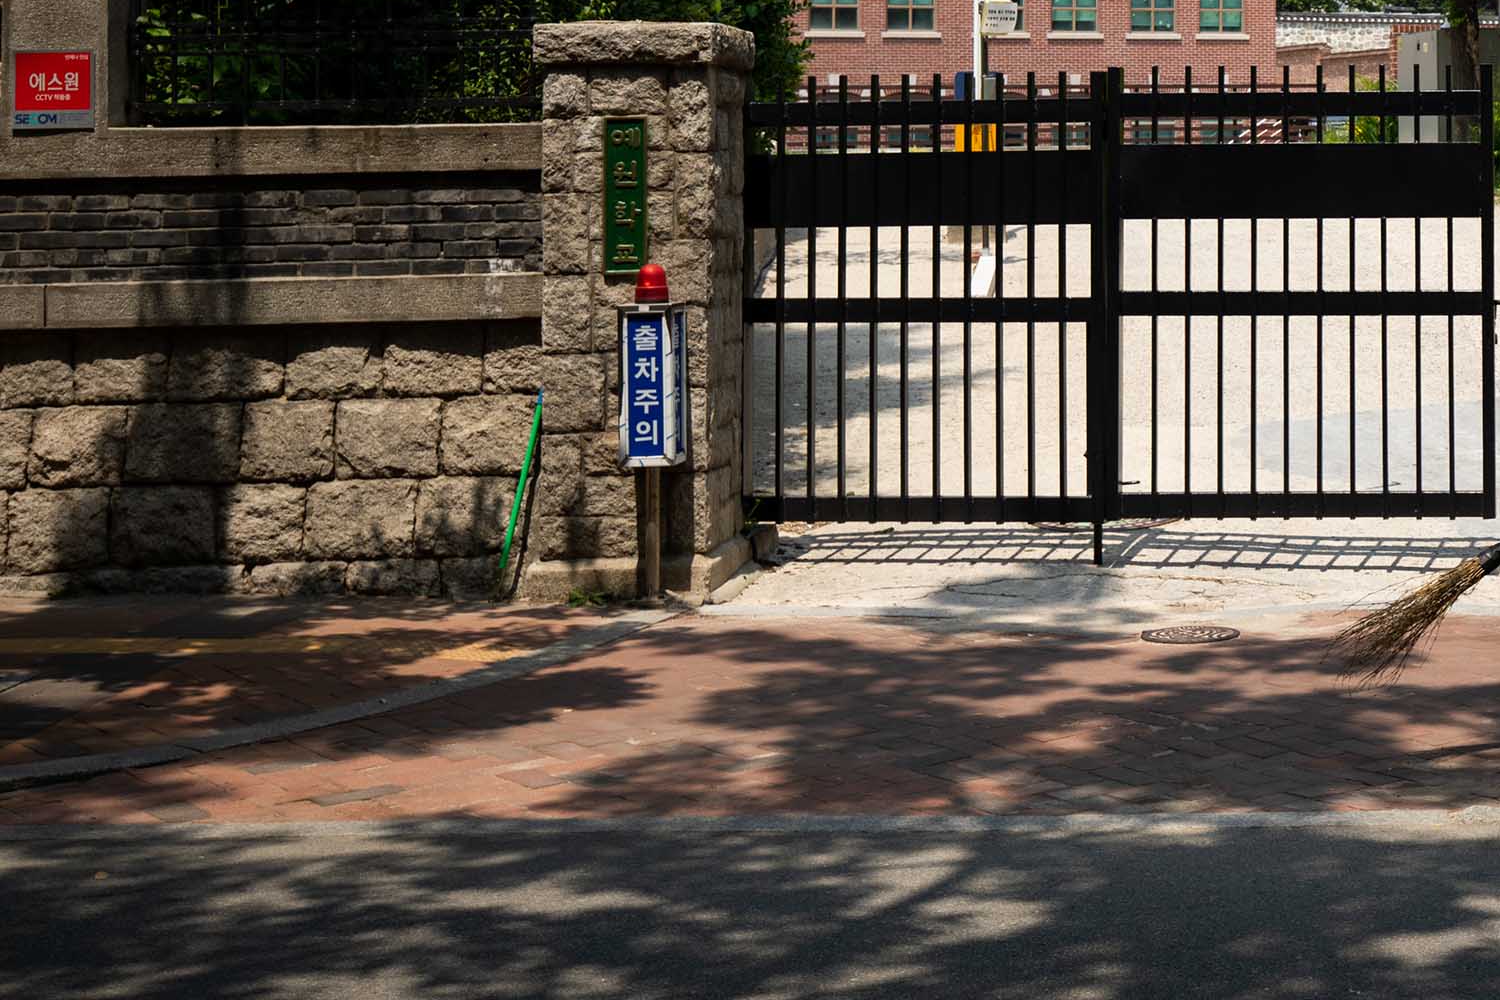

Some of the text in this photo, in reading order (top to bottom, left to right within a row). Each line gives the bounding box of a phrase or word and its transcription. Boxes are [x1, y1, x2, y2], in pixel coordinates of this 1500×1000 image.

[29, 72, 79, 91] 에스원
[15, 113, 57, 125] SECOM
[611, 127, 642, 264] 예원학교
[632, 324, 660, 446] 출차주의
